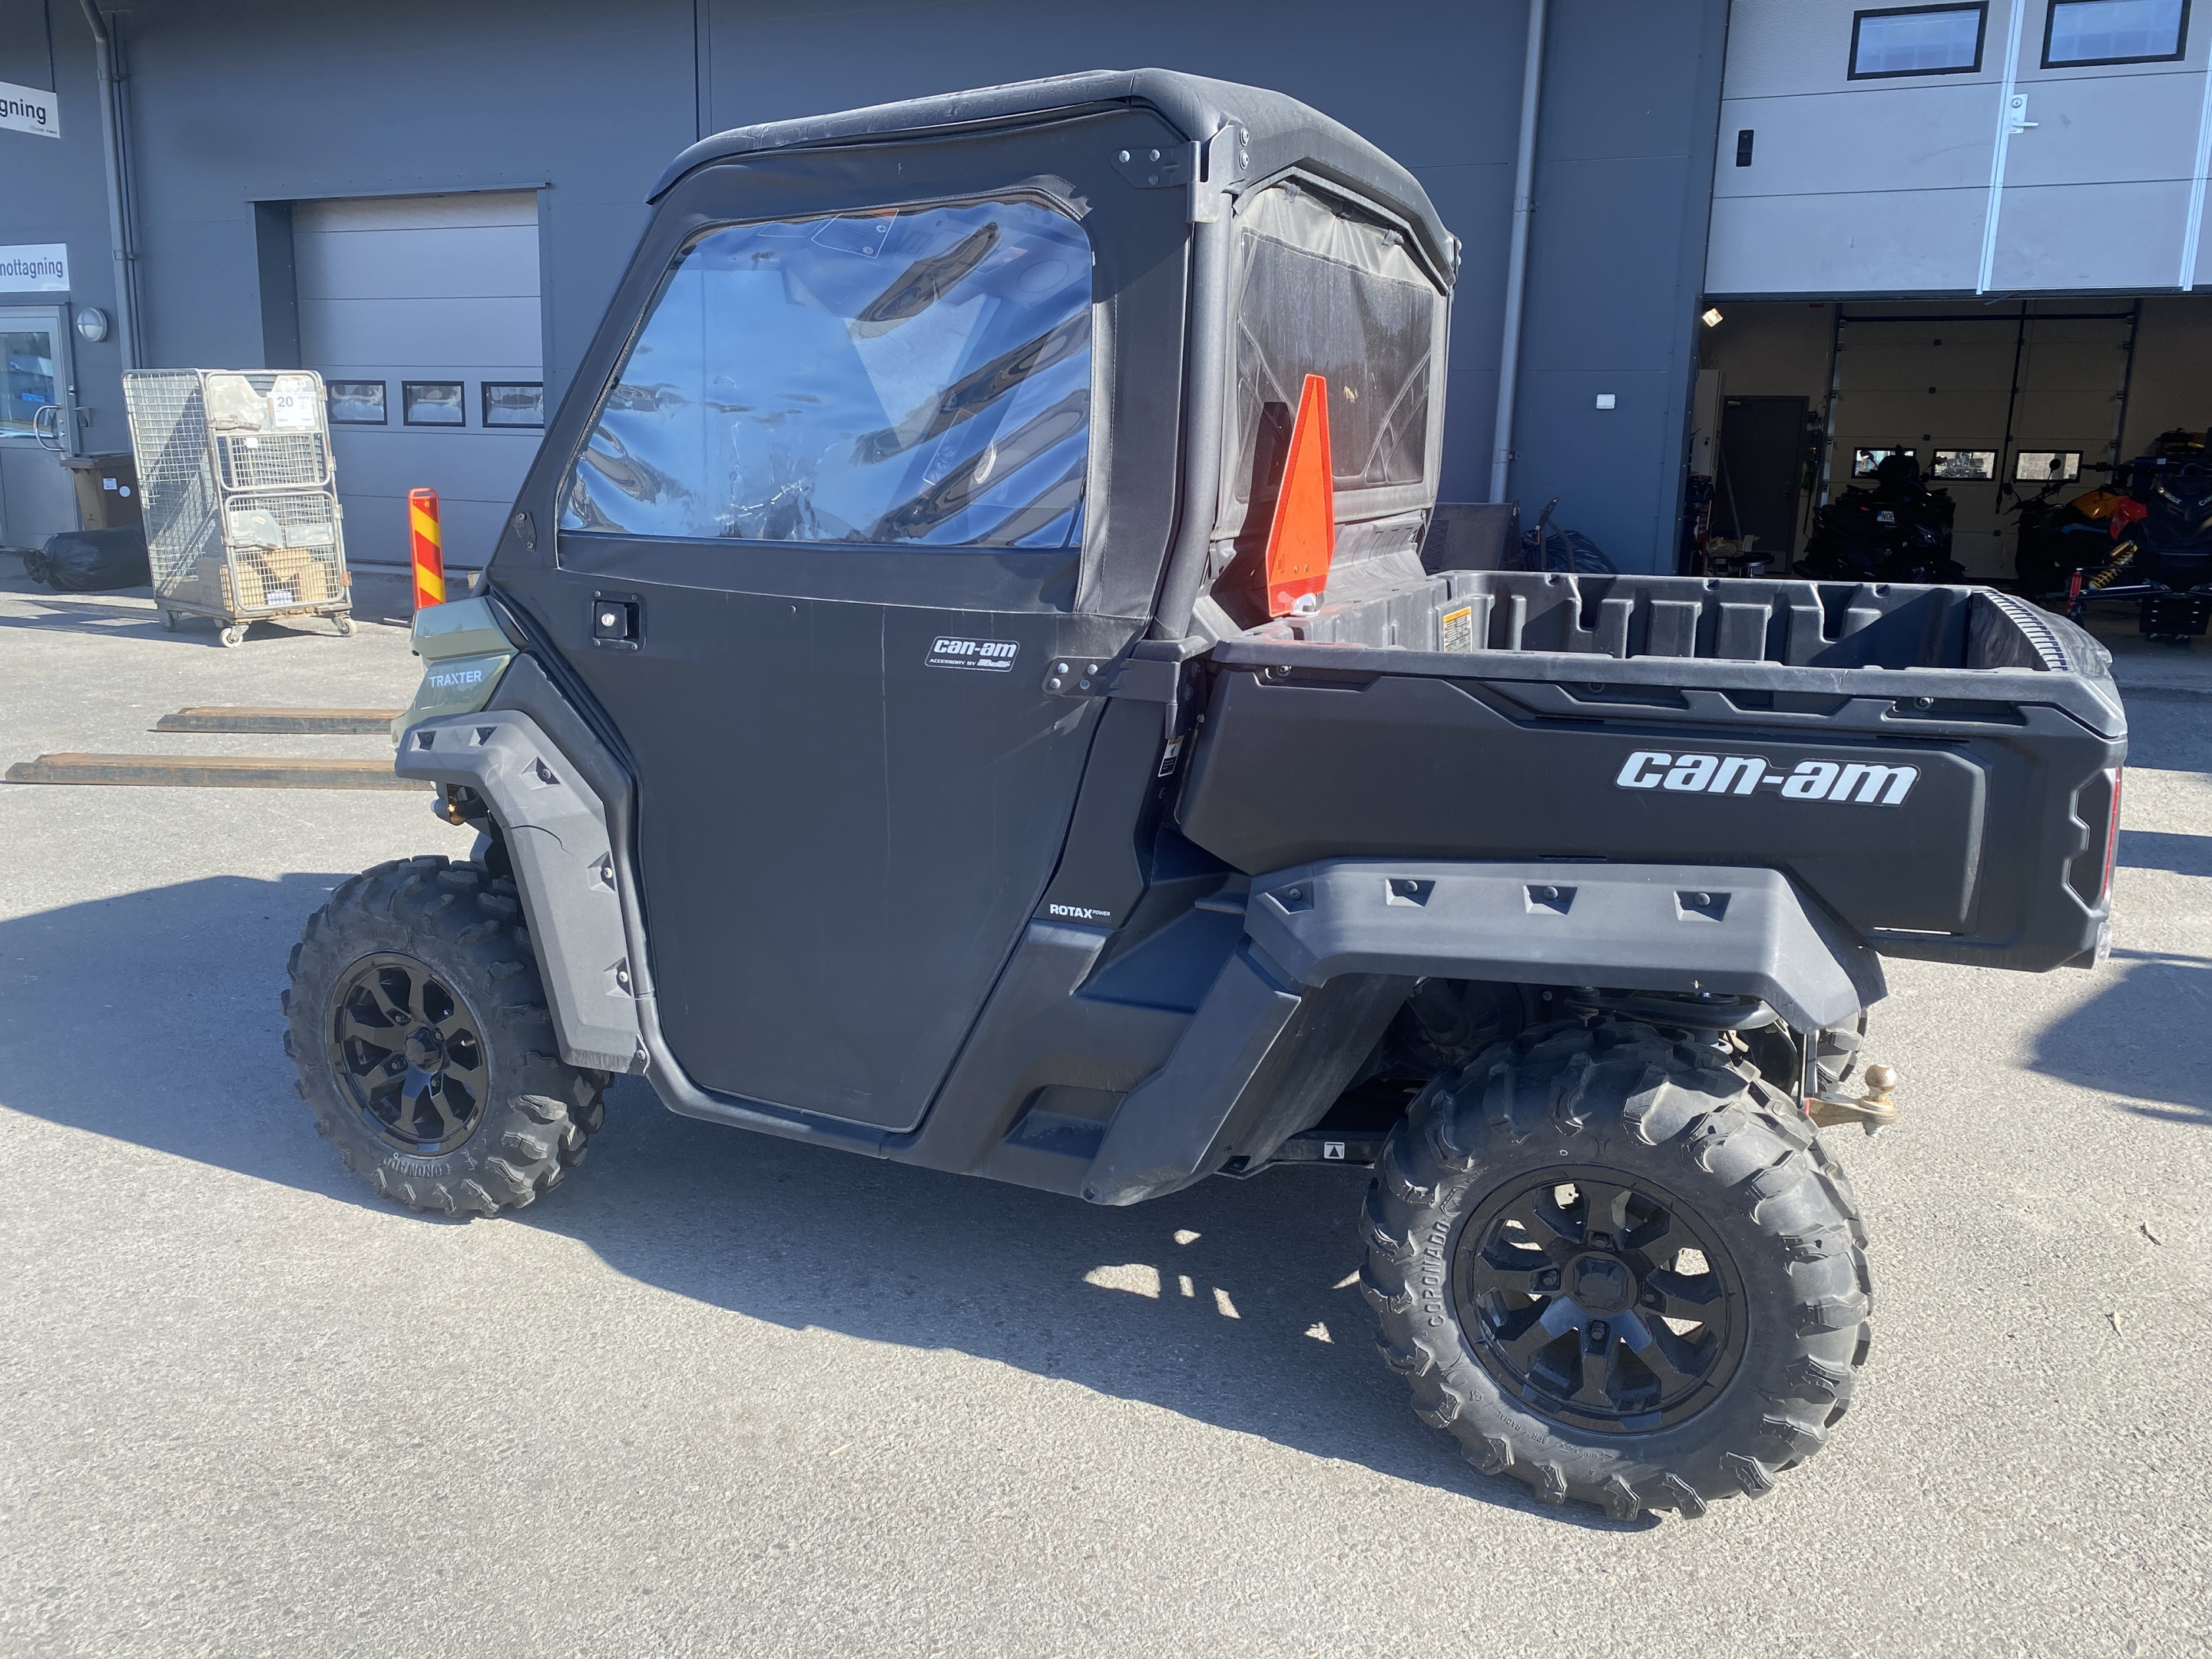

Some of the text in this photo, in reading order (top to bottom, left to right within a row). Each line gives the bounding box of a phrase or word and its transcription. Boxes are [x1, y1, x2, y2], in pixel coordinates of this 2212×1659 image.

[277, 396, 293, 407] 20
[933, 639, 1017, 658] can-am
[429, 670, 482, 687] TRAXTER
[1616, 751, 1917, 805] can-am
[1049, 903, 1093, 919] ROTAX
[1421, 1220, 1451, 1327] CORONADO
